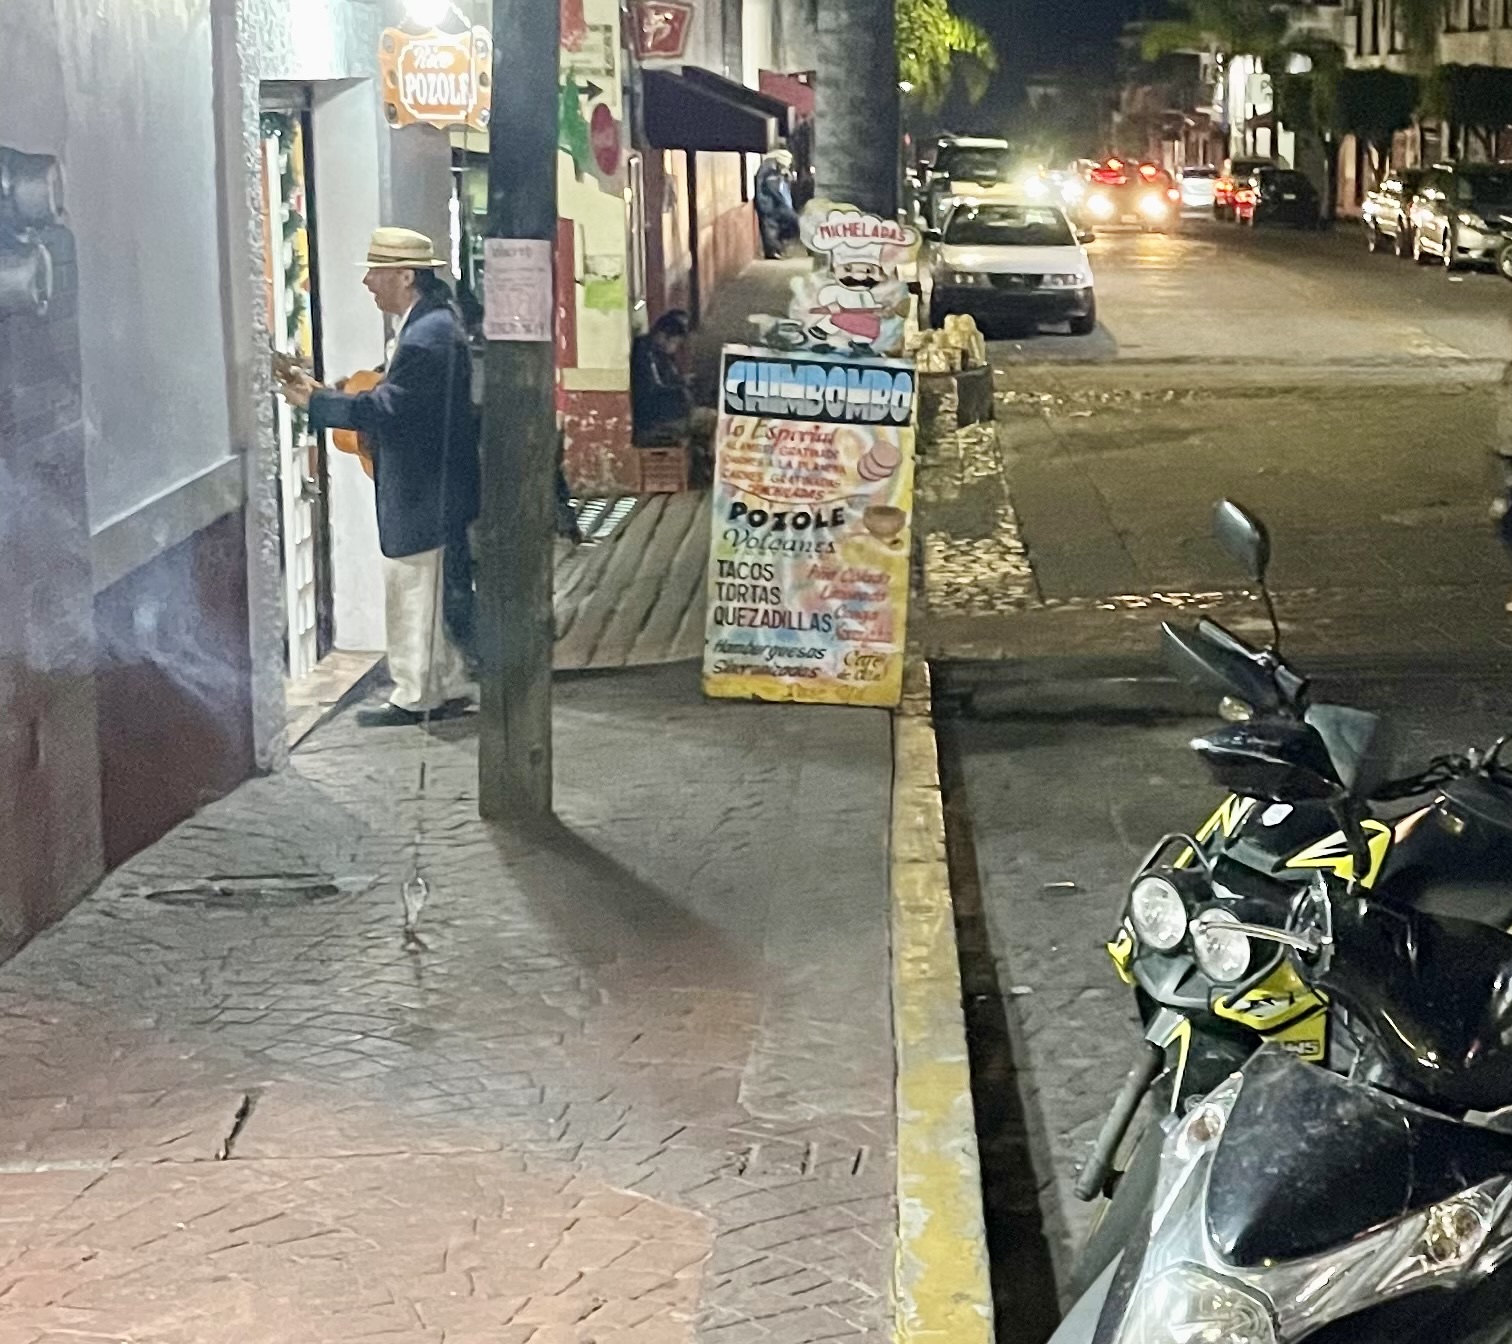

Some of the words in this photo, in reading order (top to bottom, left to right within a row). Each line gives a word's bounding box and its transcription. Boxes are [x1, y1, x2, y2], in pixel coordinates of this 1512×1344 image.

[819, 222, 906, 242] MICHELADAS
[725, 360, 913, 422] CHIMBOMBO
[729, 502, 845, 531] POZOLE
[717, 559, 775, 582] TACOS
[715, 582, 782, 605] TORTAS
[714, 606, 833, 632] QUEZADILLAS
